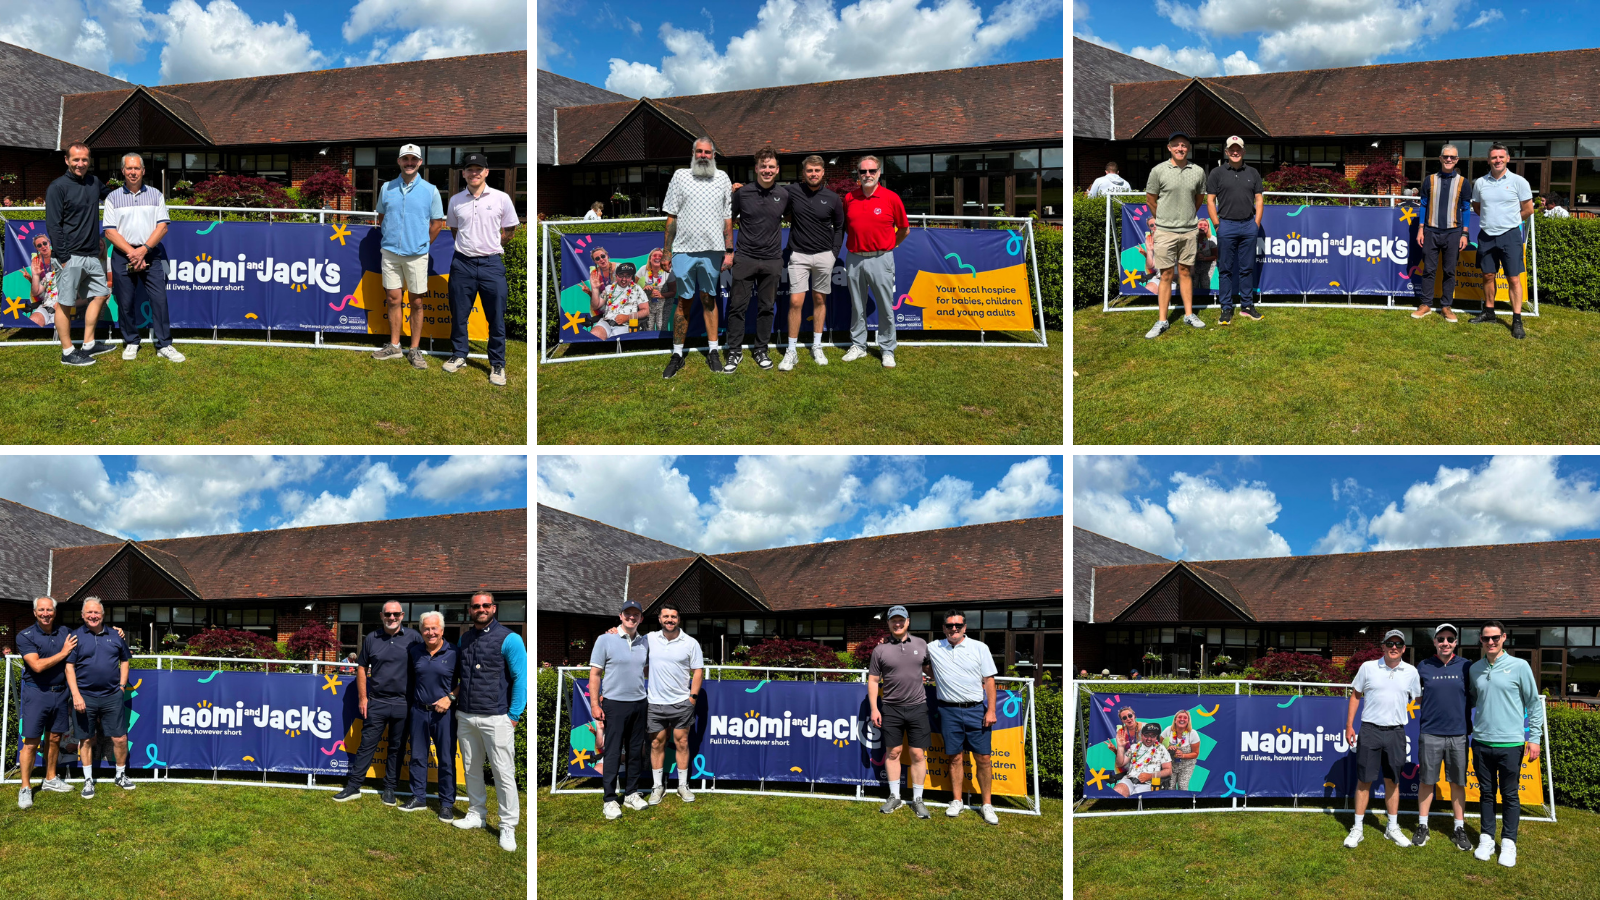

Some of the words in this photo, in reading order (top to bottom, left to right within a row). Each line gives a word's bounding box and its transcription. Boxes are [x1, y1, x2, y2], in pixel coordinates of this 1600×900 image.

[1256, 232, 1330, 257] Naomi
[1329, 238, 1344, 246] and
[1338, 235, 1408, 265] Jack's
[161, 253, 246, 283] Naomi
[246, 260, 264, 270] and
[257, 256, 340, 294] Jack's
[936, 285, 956, 293] Your
[958, 285, 980, 293] local
[981, 286, 1016, 295] hospice
[951, 297, 984, 306] babies,
[985, 297, 1023, 305] children
[936, 308, 955, 316] and
[957, 309, 985, 318] young
[162, 701, 244, 728] Naomi
[244, 707, 261, 716] and
[253, 704, 332, 739] Jack's
[710, 711, 792, 738] Naomi
[792, 717, 808, 726] and
[801, 714, 881, 749] Jack's
[1241, 726, 1324, 754] Naomi
[1324, 732, 1341, 741] and
[1254, 754, 1273, 762] lives,
